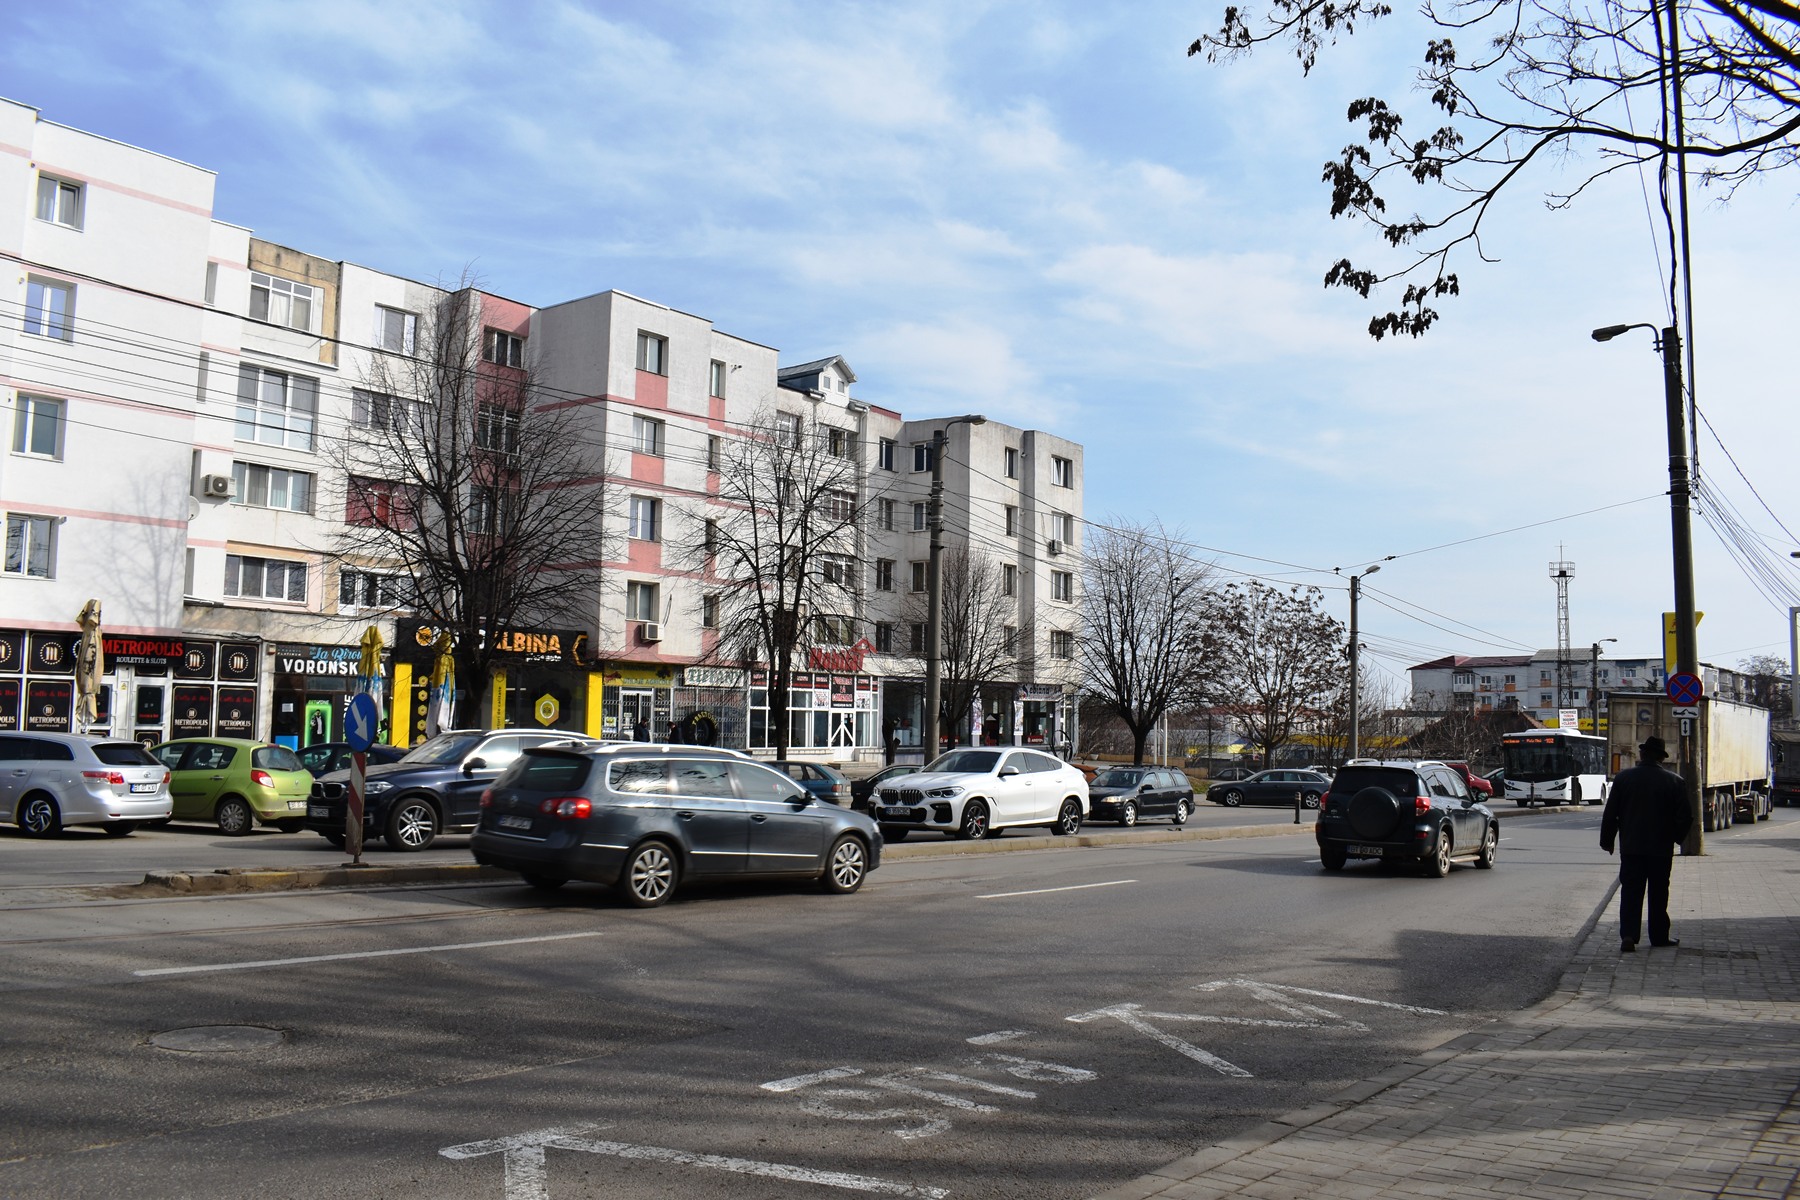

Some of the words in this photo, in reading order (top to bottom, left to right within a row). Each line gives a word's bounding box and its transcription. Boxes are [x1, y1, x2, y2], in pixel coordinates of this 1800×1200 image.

[103, 639, 183, 657] METROPOLIS
[313, 647, 329, 660] La
[116, 656, 145, 664] ROULETTE
[283, 658, 386, 676] VORONSKA
[29, 716, 67, 724] METROPOLIS
[174, 718, 208, 726] METROPOLIS
[219, 719, 251, 727] METROPOLIS
